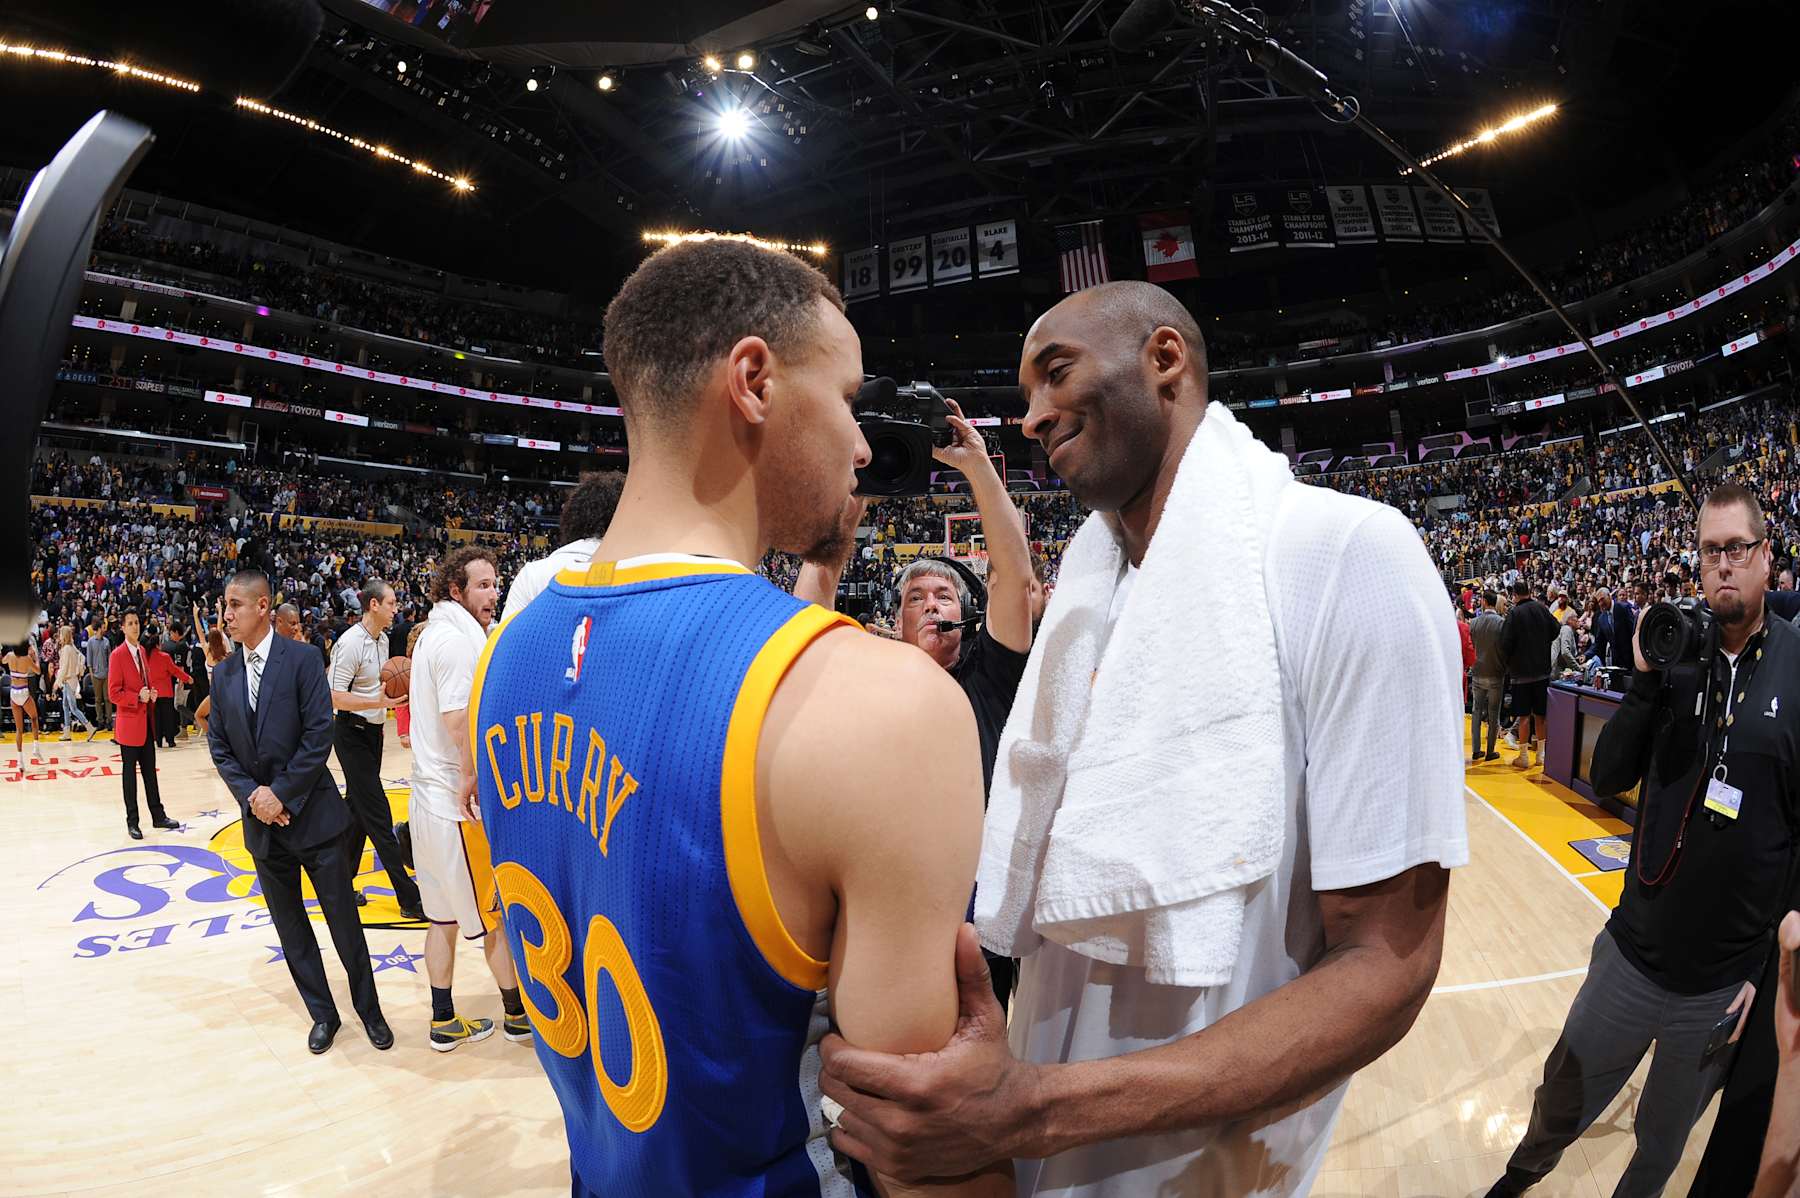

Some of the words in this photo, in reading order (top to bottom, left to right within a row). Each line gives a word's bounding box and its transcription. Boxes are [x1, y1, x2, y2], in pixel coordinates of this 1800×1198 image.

[1228, 217, 1256, 226] STANLEY
[1257, 214, 1271, 222] CUP
[1283, 214, 1310, 222] STANLEY
[984, 227, 1008, 237] BLAKE
[1229, 221, 1273, 234] CHAMPIONS
[1284, 221, 1328, 230] CHAMPIONS
[1237, 231, 1270, 244] 2013-14
[1294, 231, 1324, 241] 2011-12
[991, 240, 1004, 261] 4
[938, 246, 966, 271] 20
[894, 255, 923, 279] 99
[851, 267, 871, 289] 18
[1667, 360, 1695, 375] TOYOTA
[72, 375, 97, 383] DELTA
[135, 381, 165, 393] STAPLES
[290, 404, 323, 417] TOYOTA
[485, 711, 640, 858] CURRY
[493, 861, 669, 1134] 30
